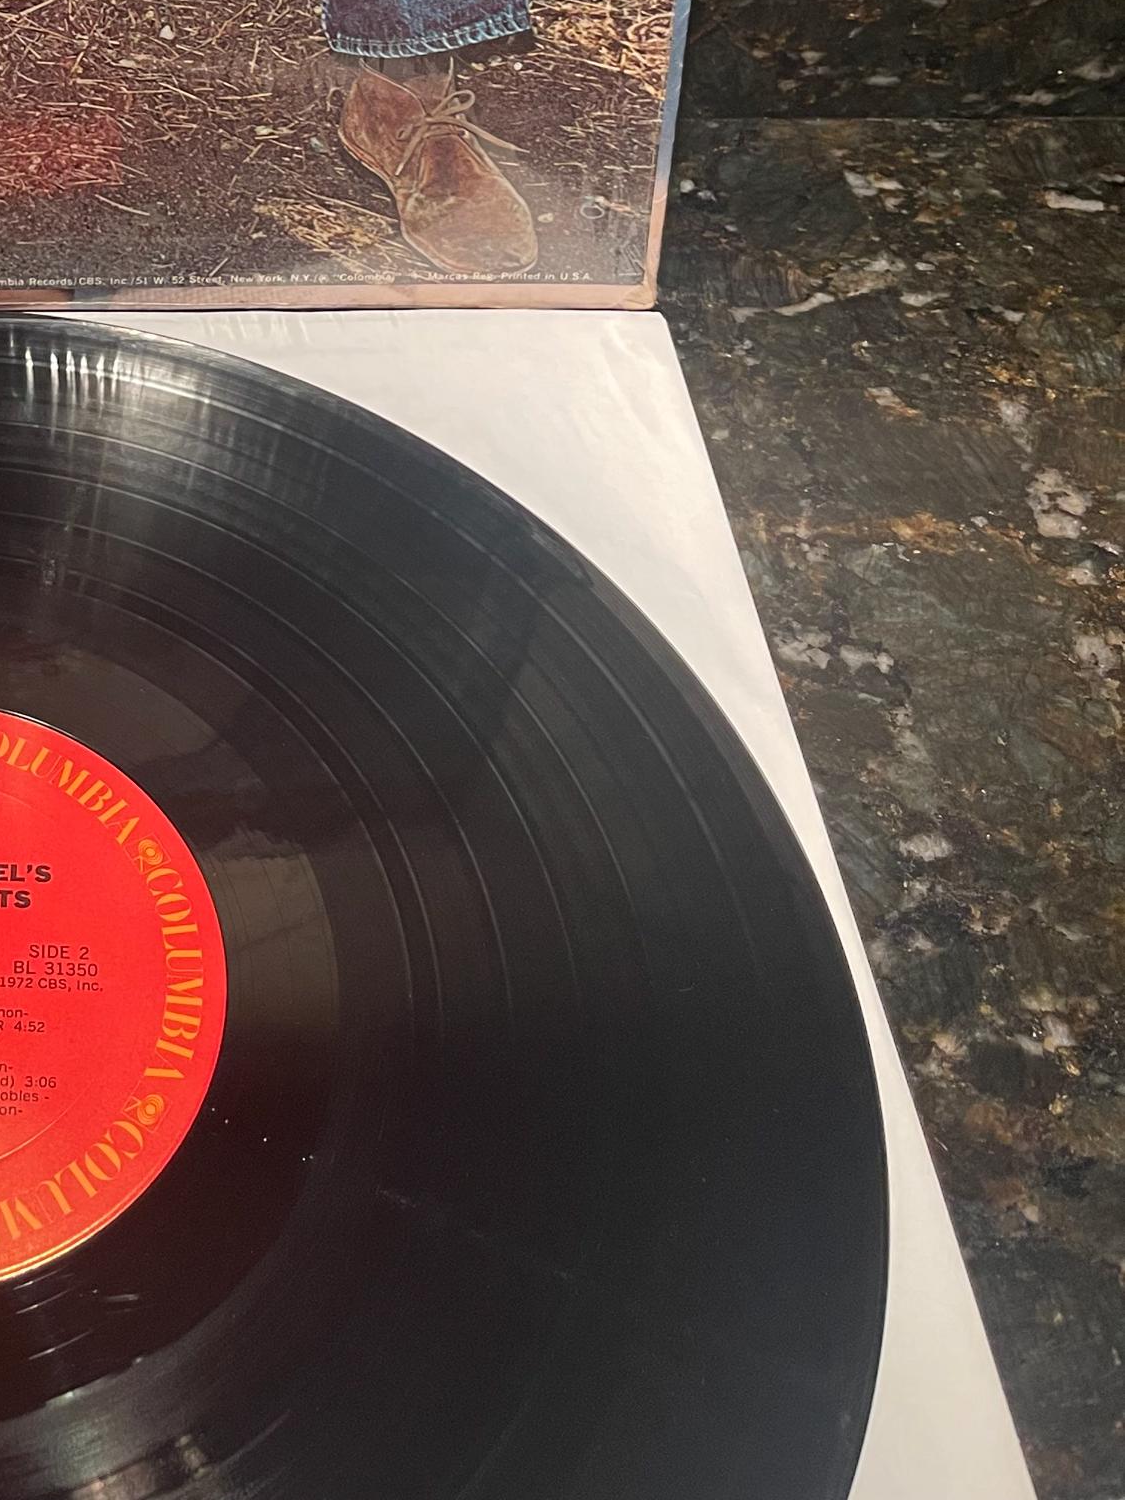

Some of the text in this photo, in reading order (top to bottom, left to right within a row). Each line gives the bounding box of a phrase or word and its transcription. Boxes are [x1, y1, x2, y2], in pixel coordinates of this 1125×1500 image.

[231, 275, 253, 283] New
[29, 945, 90, 959] SIDE 2
[13, 961, 98, 976] BL 31350
[144, 868, 204, 1080] COLUMBIA
[0, 977, 104, 993] 1972 CBS, Inc.
[14, 1022, 45, 1033] 4:52
[25, 1076, 56, 1088] 3:06
